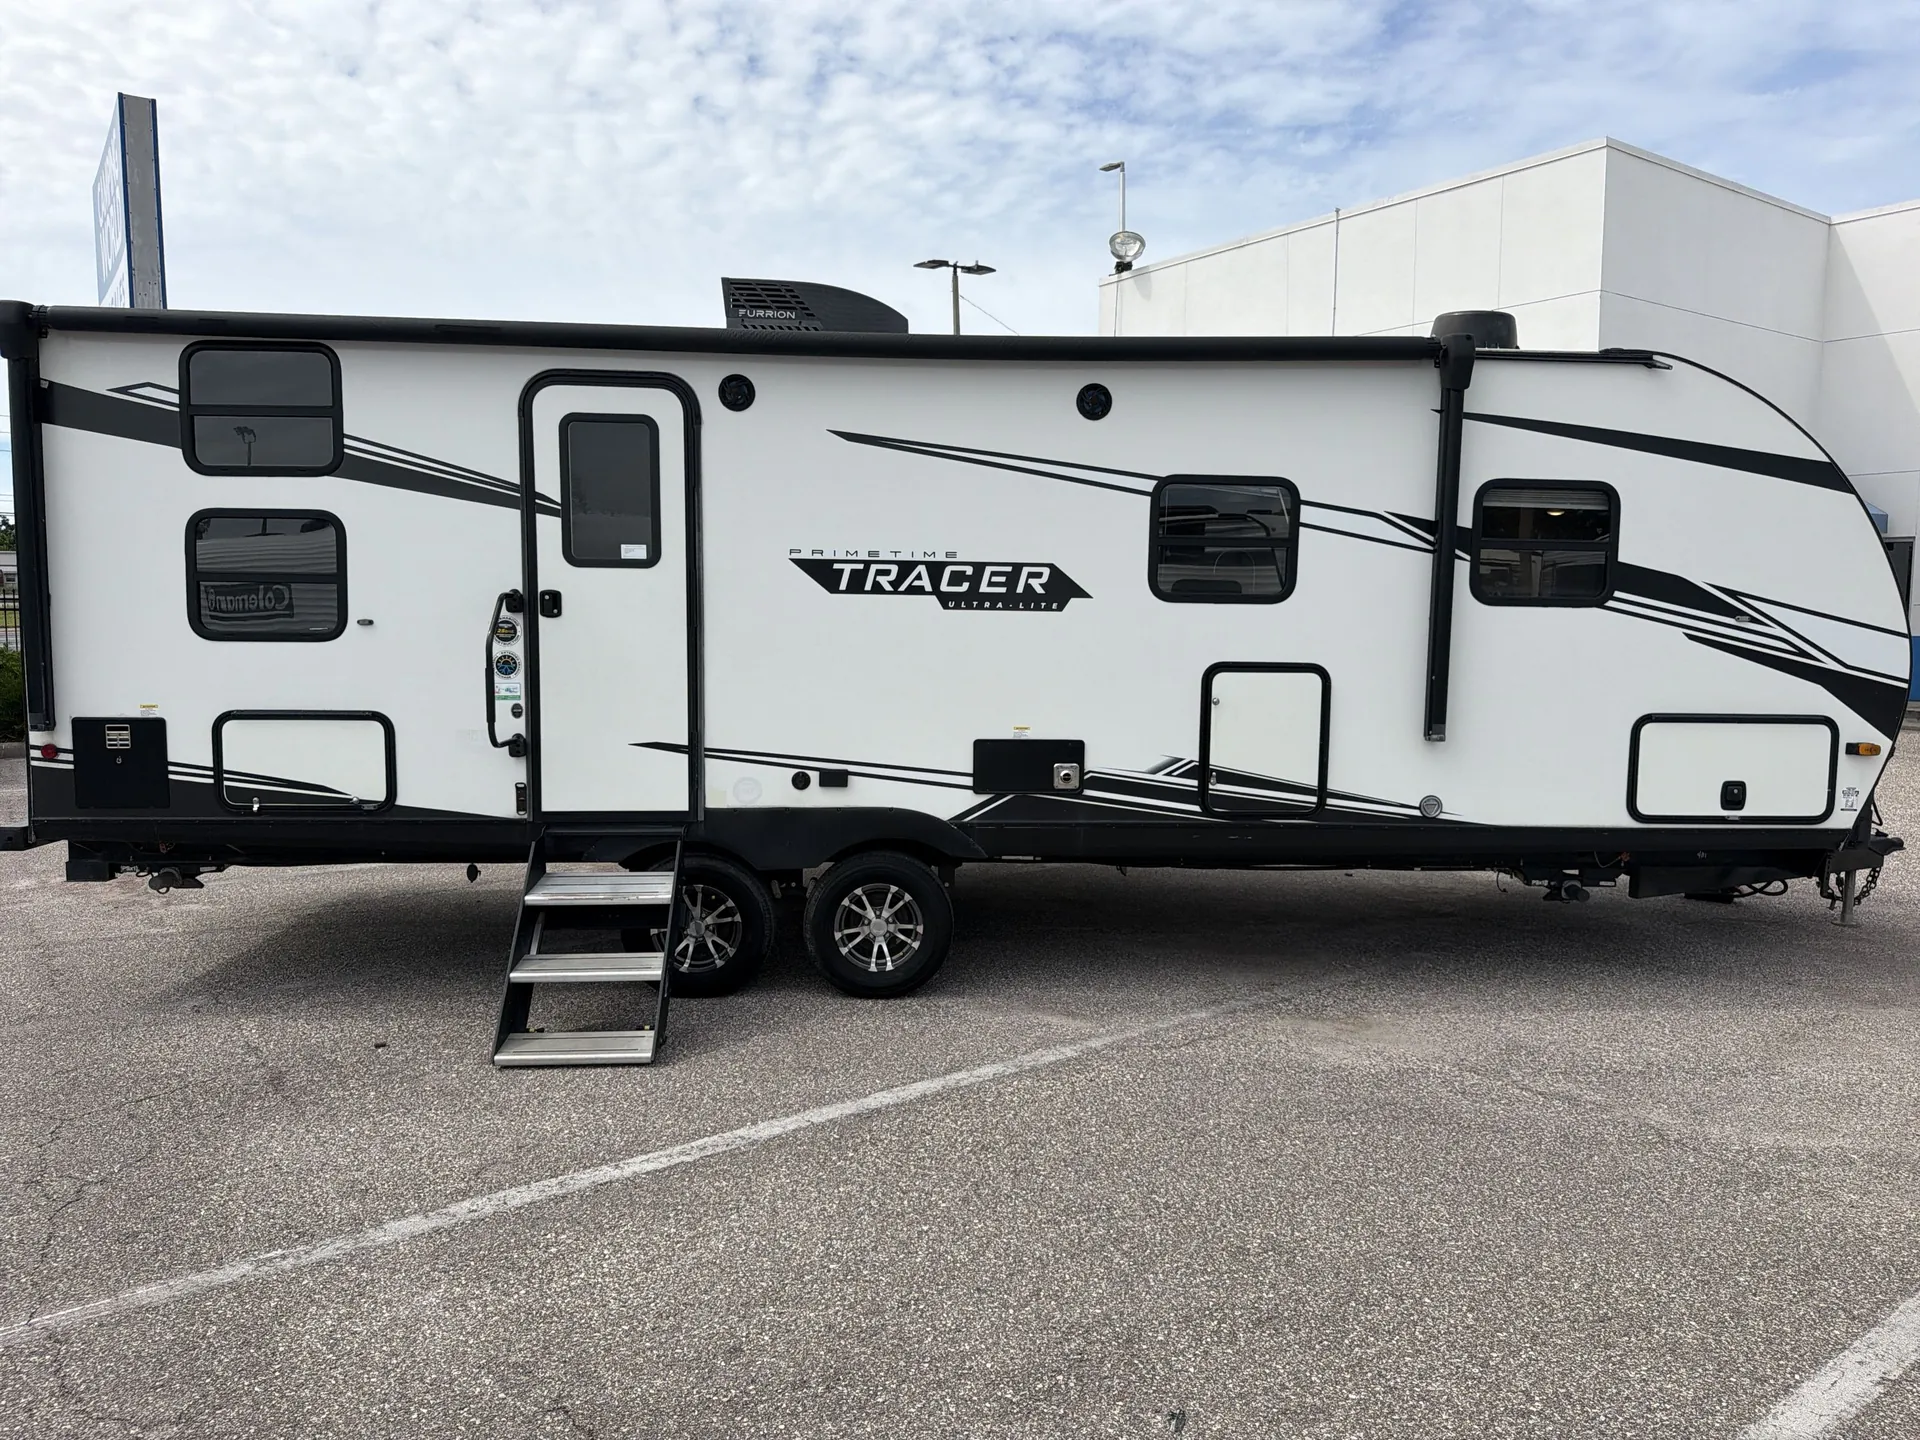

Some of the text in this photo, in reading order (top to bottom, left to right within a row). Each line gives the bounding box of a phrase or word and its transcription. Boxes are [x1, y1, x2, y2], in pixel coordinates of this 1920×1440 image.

[738, 309, 796, 319] FURRION
[789, 548, 958, 559] PRIMETIME
[832, 562, 1051, 594] TRACER
